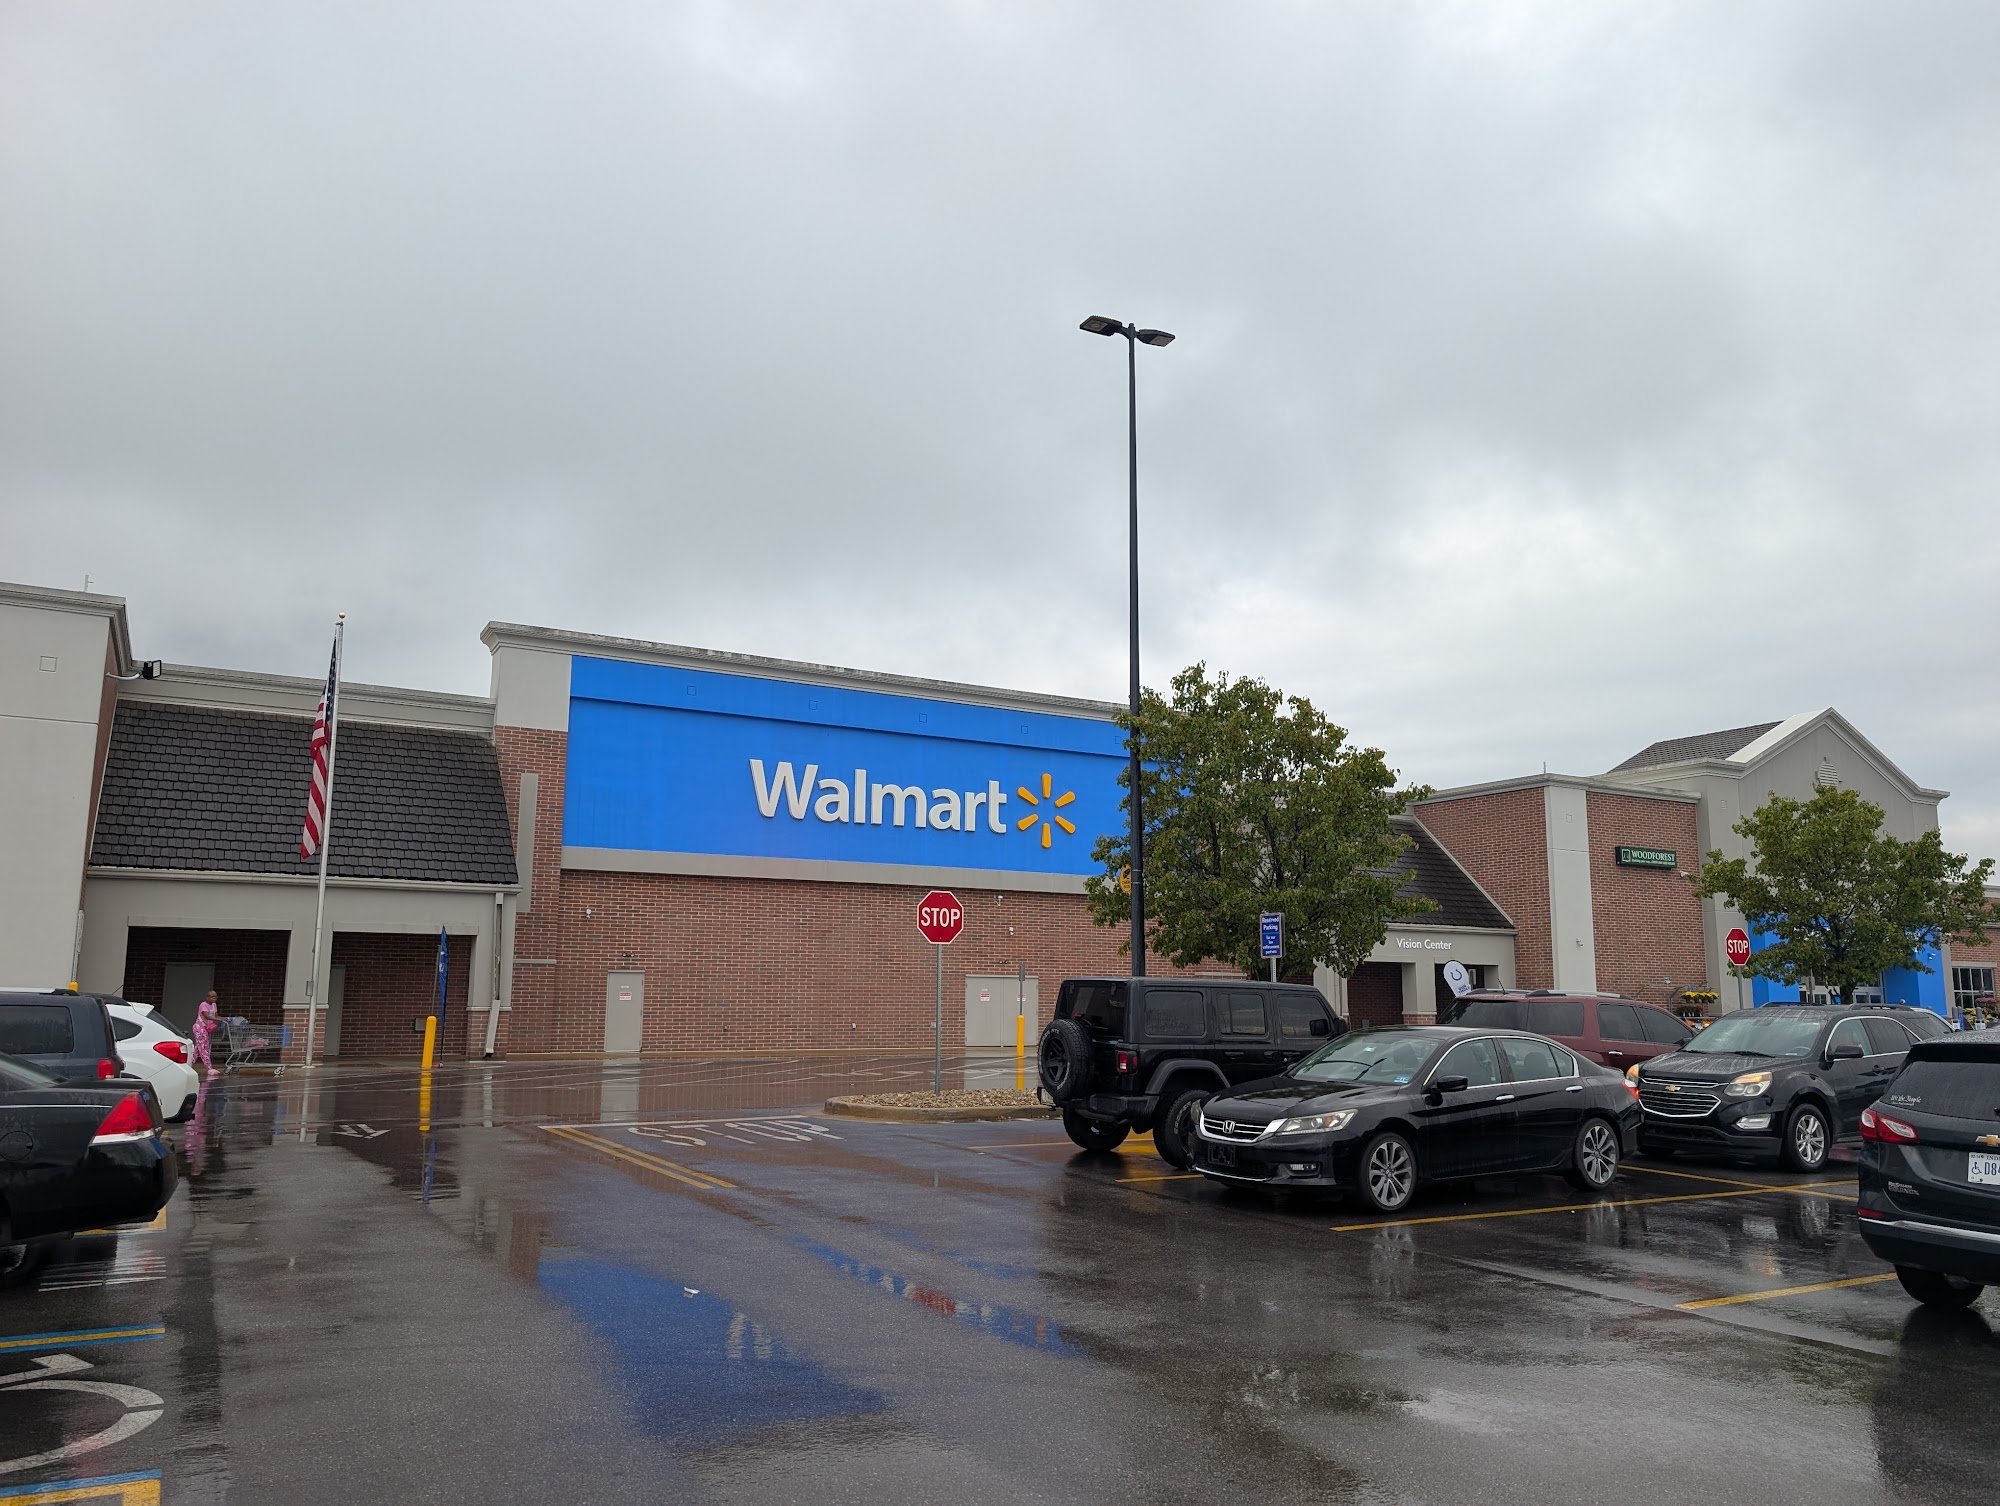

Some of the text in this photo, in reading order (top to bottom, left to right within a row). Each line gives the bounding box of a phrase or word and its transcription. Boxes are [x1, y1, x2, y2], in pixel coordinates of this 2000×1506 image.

[749, 758, 1007, 833] Walmart
[1631, 850, 1675, 861] WOODFOREST
[921, 907, 960, 927] STOP
[1396, 938, 1452, 949] Vision Center
[1728, 939, 1748, 953] STOP
[627, 1120, 847, 1146] STOP
